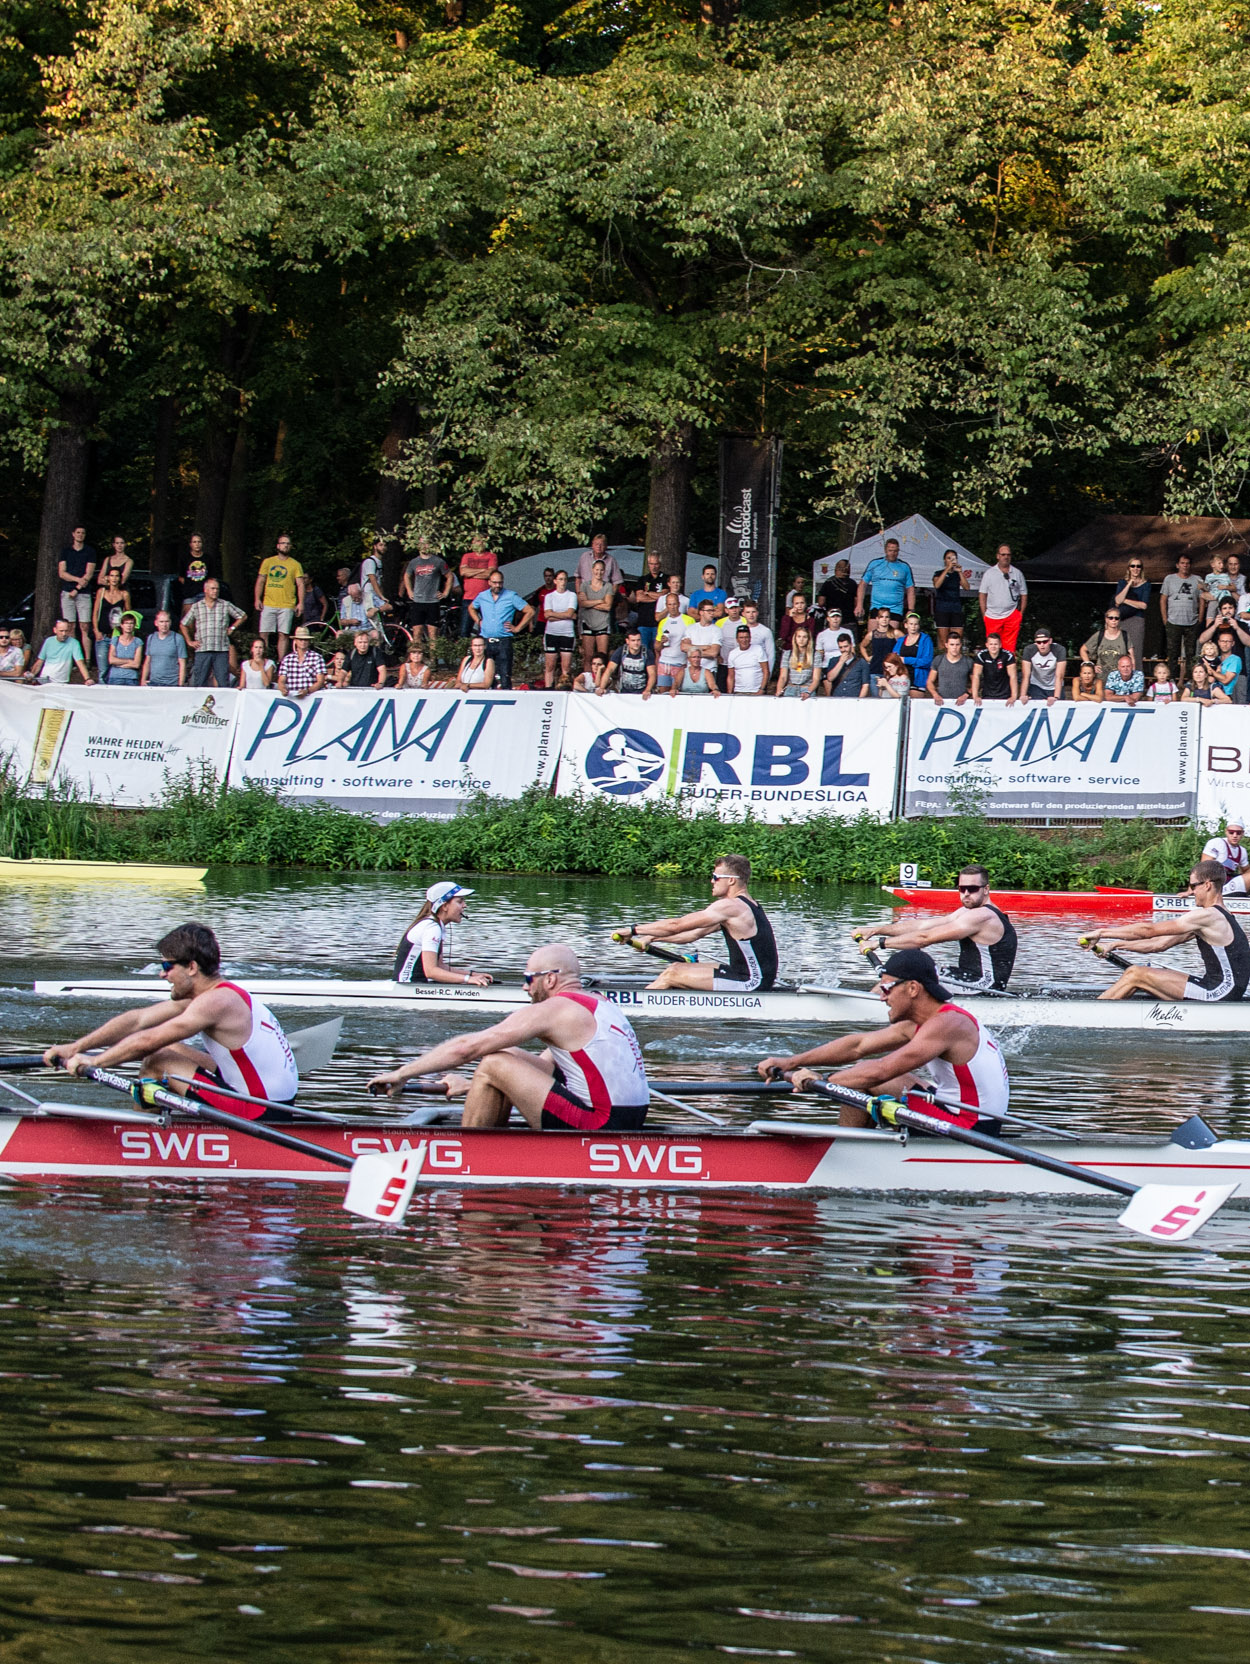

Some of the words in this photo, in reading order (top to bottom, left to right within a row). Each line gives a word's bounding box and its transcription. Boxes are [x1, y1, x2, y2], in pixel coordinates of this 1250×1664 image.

[738, 488, 752, 549] Broadcast
[738, 550, 751, 573] Live
[88, 735, 123, 747] WAHRE
[126, 739, 164, 749] HELDEN
[244, 697, 517, 768] PLANAT
[536, 700, 554, 778] ww.planat.de
[918, 707, 1155, 767] PLANAT
[85, 748, 120, 760] SETZEN
[123, 750, 168, 763] ZEICHEN.
[1177, 710, 1188, 784] www.planat.de
[681, 732, 870, 787] RBL
[342, 775, 414, 788] software
[432, 777, 491, 790] service
[1008, 773, 1071, 784] software
[1088, 775, 1140, 786] service
[679, 787, 868, 803] RUDER-BUNDESLIGA
[1030, 801, 1044, 810] für
[1046, 802, 1062, 810] den
[1065, 802, 1134, 811] produzierenden
[1136, 801, 1186, 810] Mittelstand
[904, 864, 914, 879] 9
[1167, 898, 1190, 907] RBL
[454, 988, 480, 997] Minden
[606, 991, 643, 1004] RBL
[647, 994, 762, 1008] RUDER-BUNDESLIGA
[1144, 1002, 1185, 1022] Melitta
[92, 1067, 131, 1090] Sparkasse
[825, 1081, 874, 1103] Giessen
[121, 1131, 230, 1162] SWG
[589, 1143, 703, 1174] SWG
